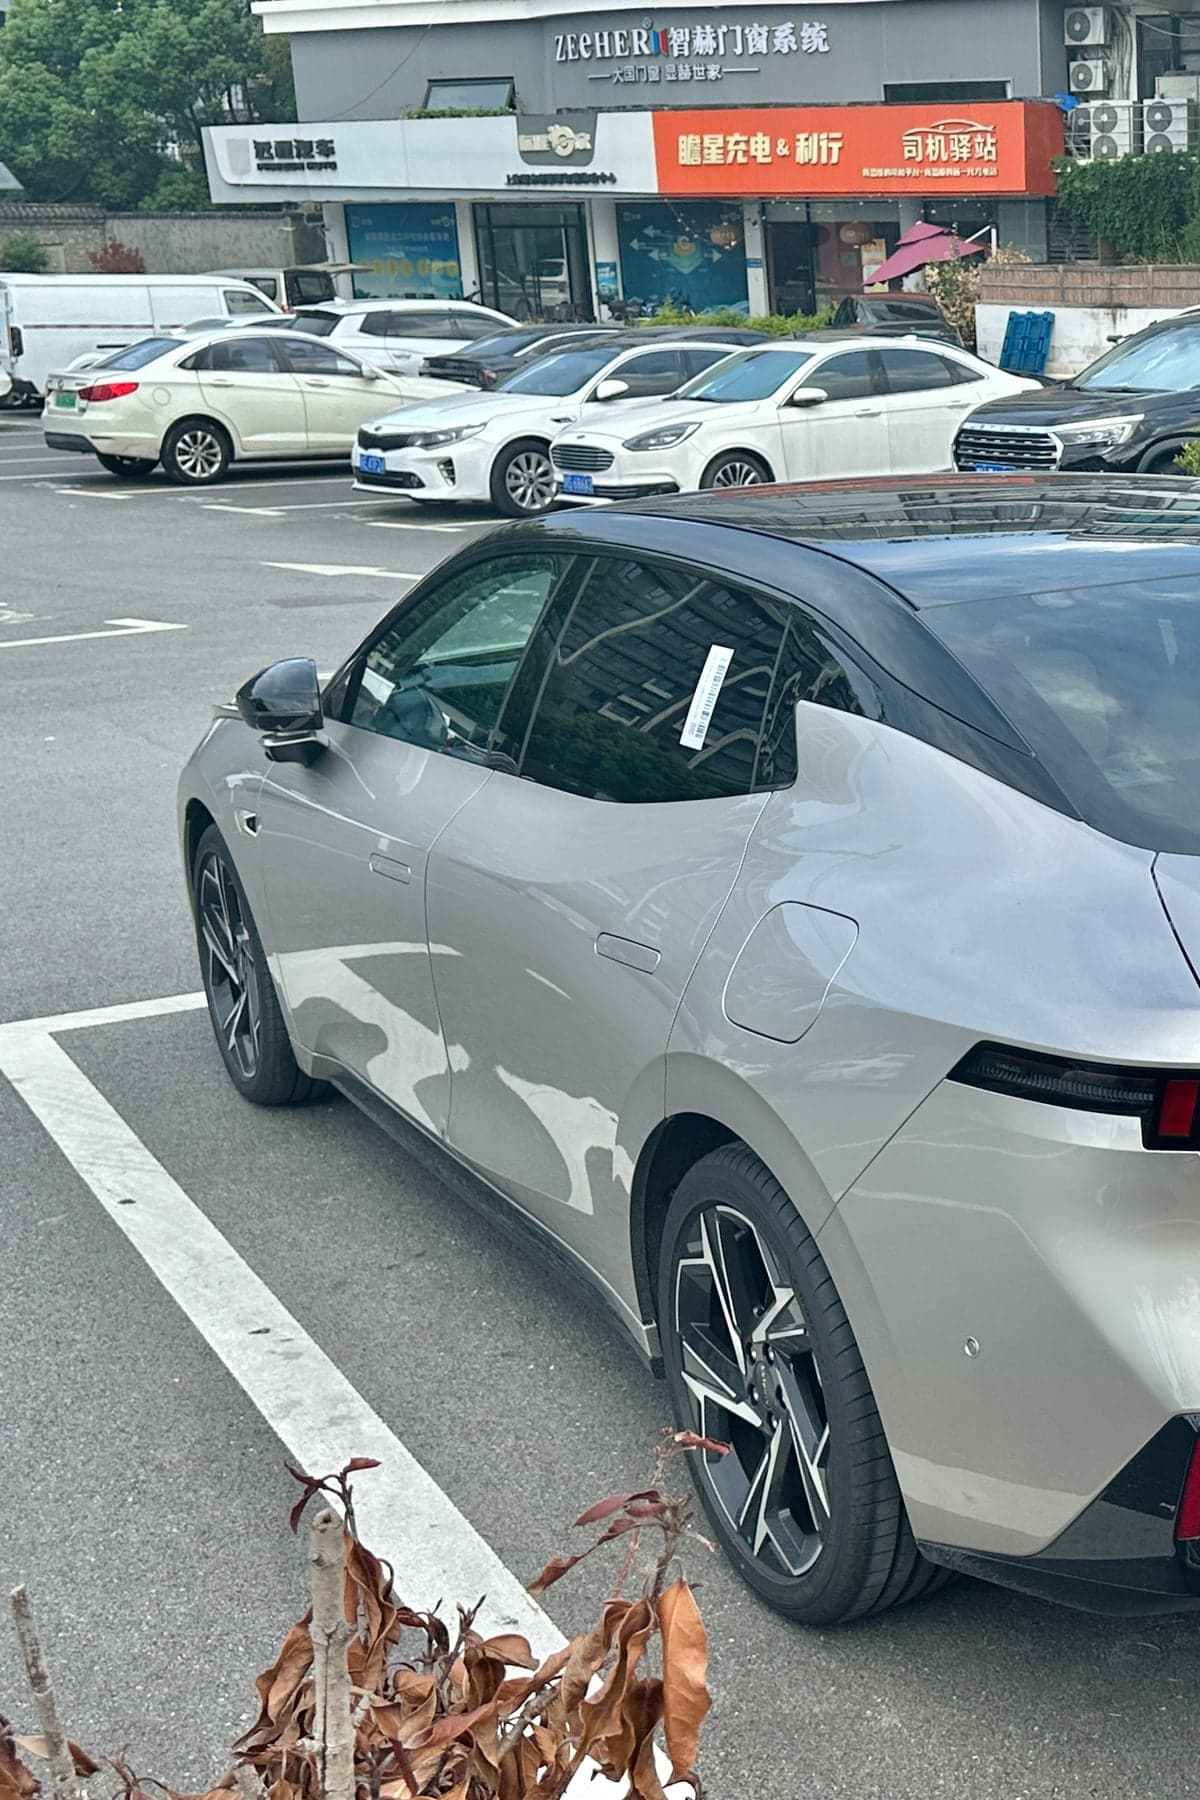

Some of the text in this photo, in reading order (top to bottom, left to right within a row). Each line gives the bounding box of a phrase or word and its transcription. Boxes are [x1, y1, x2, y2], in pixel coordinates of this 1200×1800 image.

[668, 21, 831, 59] 智赫门窗系统
[665, 63, 724, 82] 显赫世家
[678, 132, 844, 166] 瞻星充电 & 利行
[902, 132, 998, 163] 司机驿站
